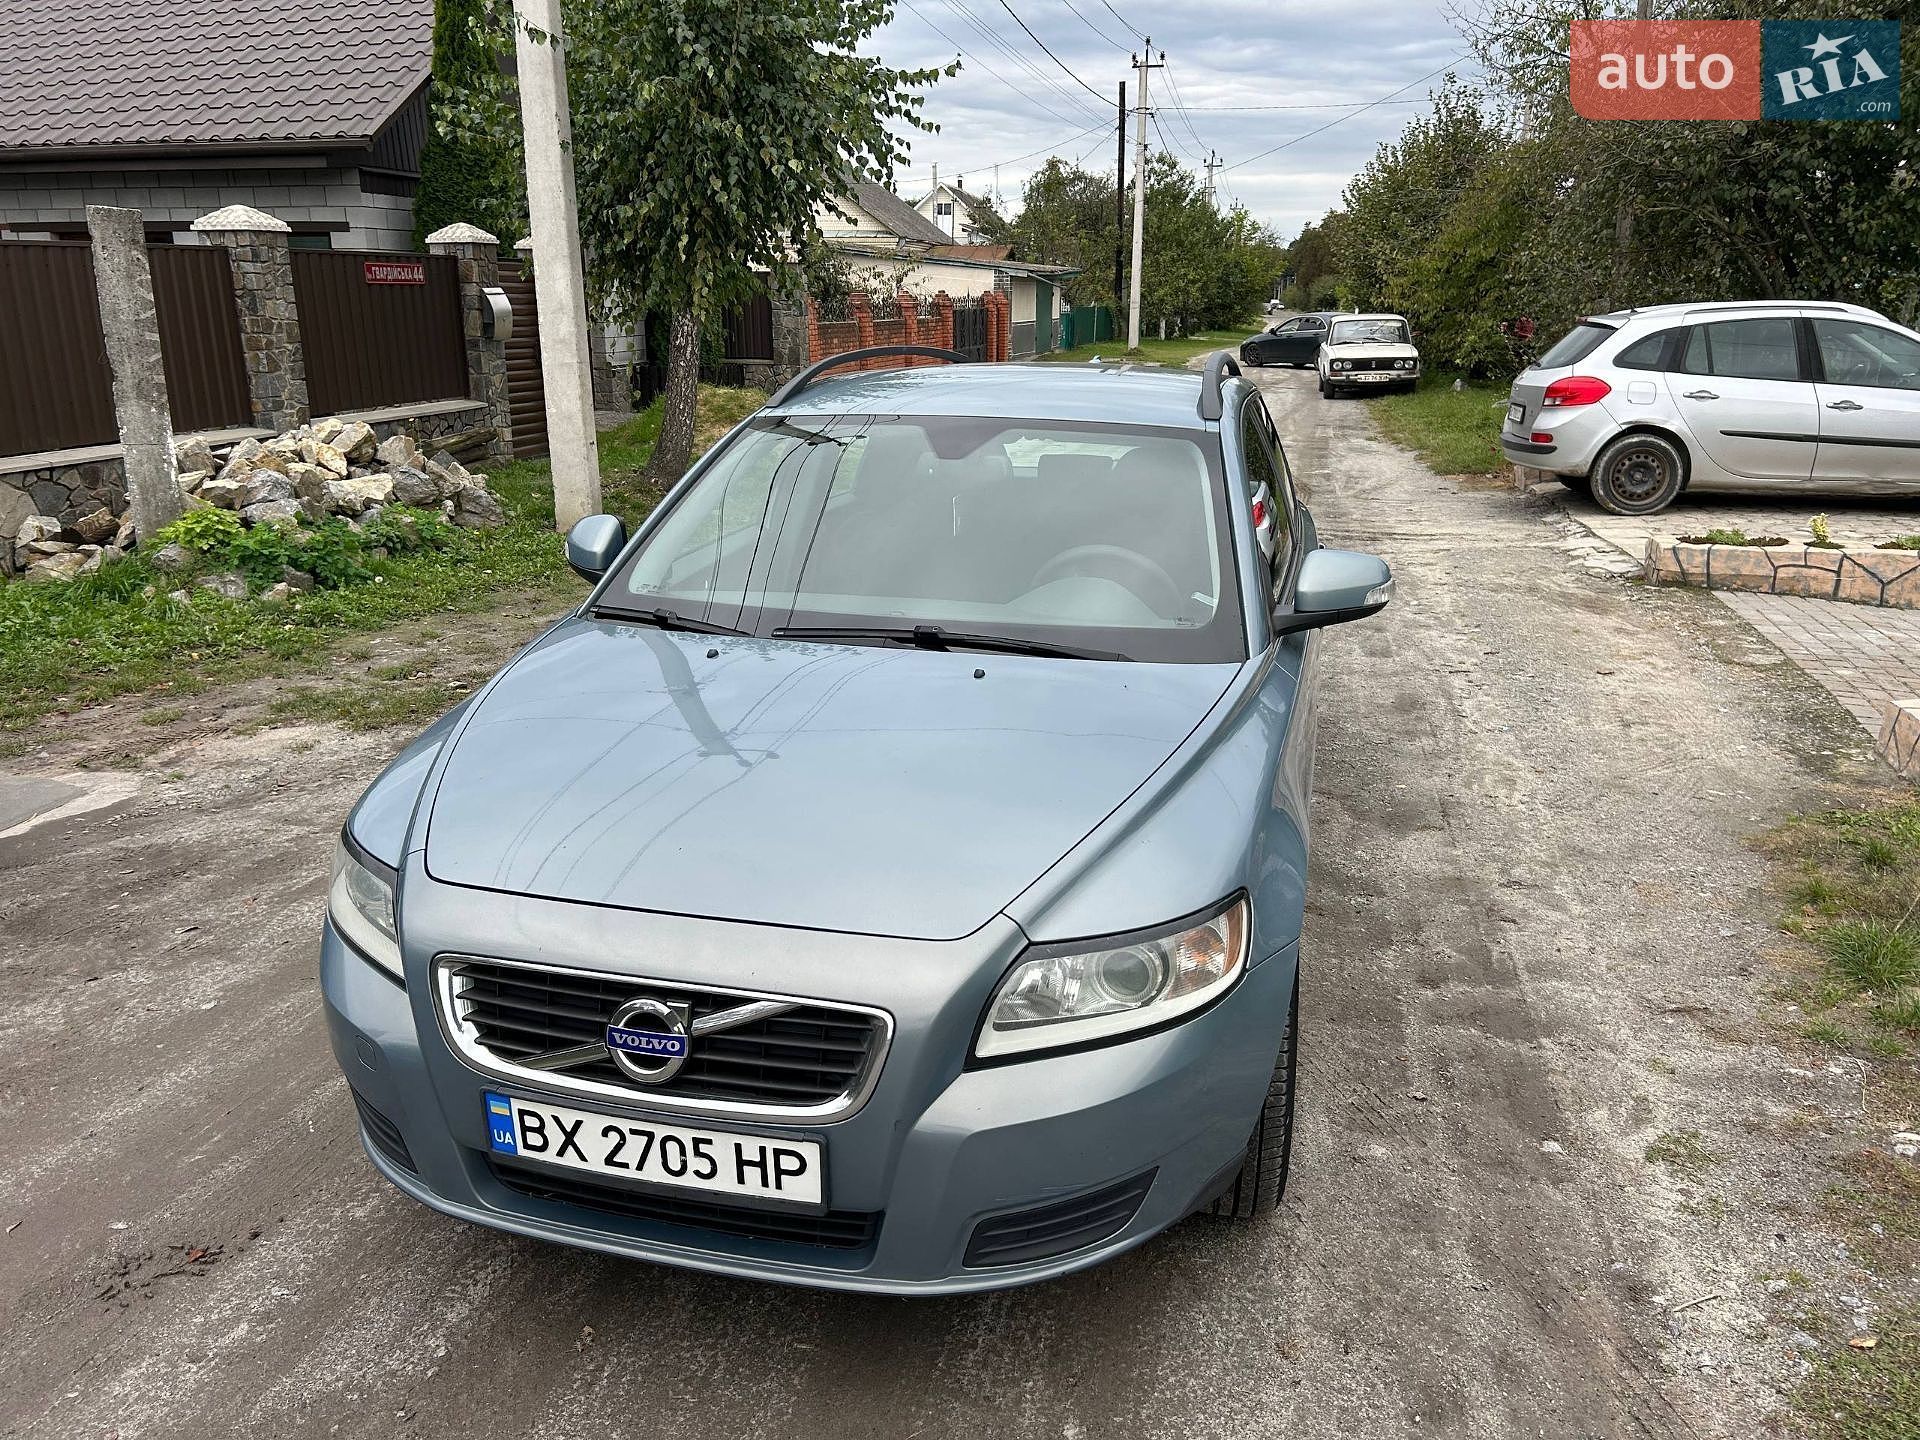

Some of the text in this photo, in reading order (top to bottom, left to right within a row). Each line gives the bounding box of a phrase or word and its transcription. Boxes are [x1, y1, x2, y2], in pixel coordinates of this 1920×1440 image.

[413, 266, 424, 282] 44
[611, 1031, 681, 1052] VOLVO
[493, 1128, 515, 1146] UA
[517, 1108, 808, 1191] BX 2705 HP
